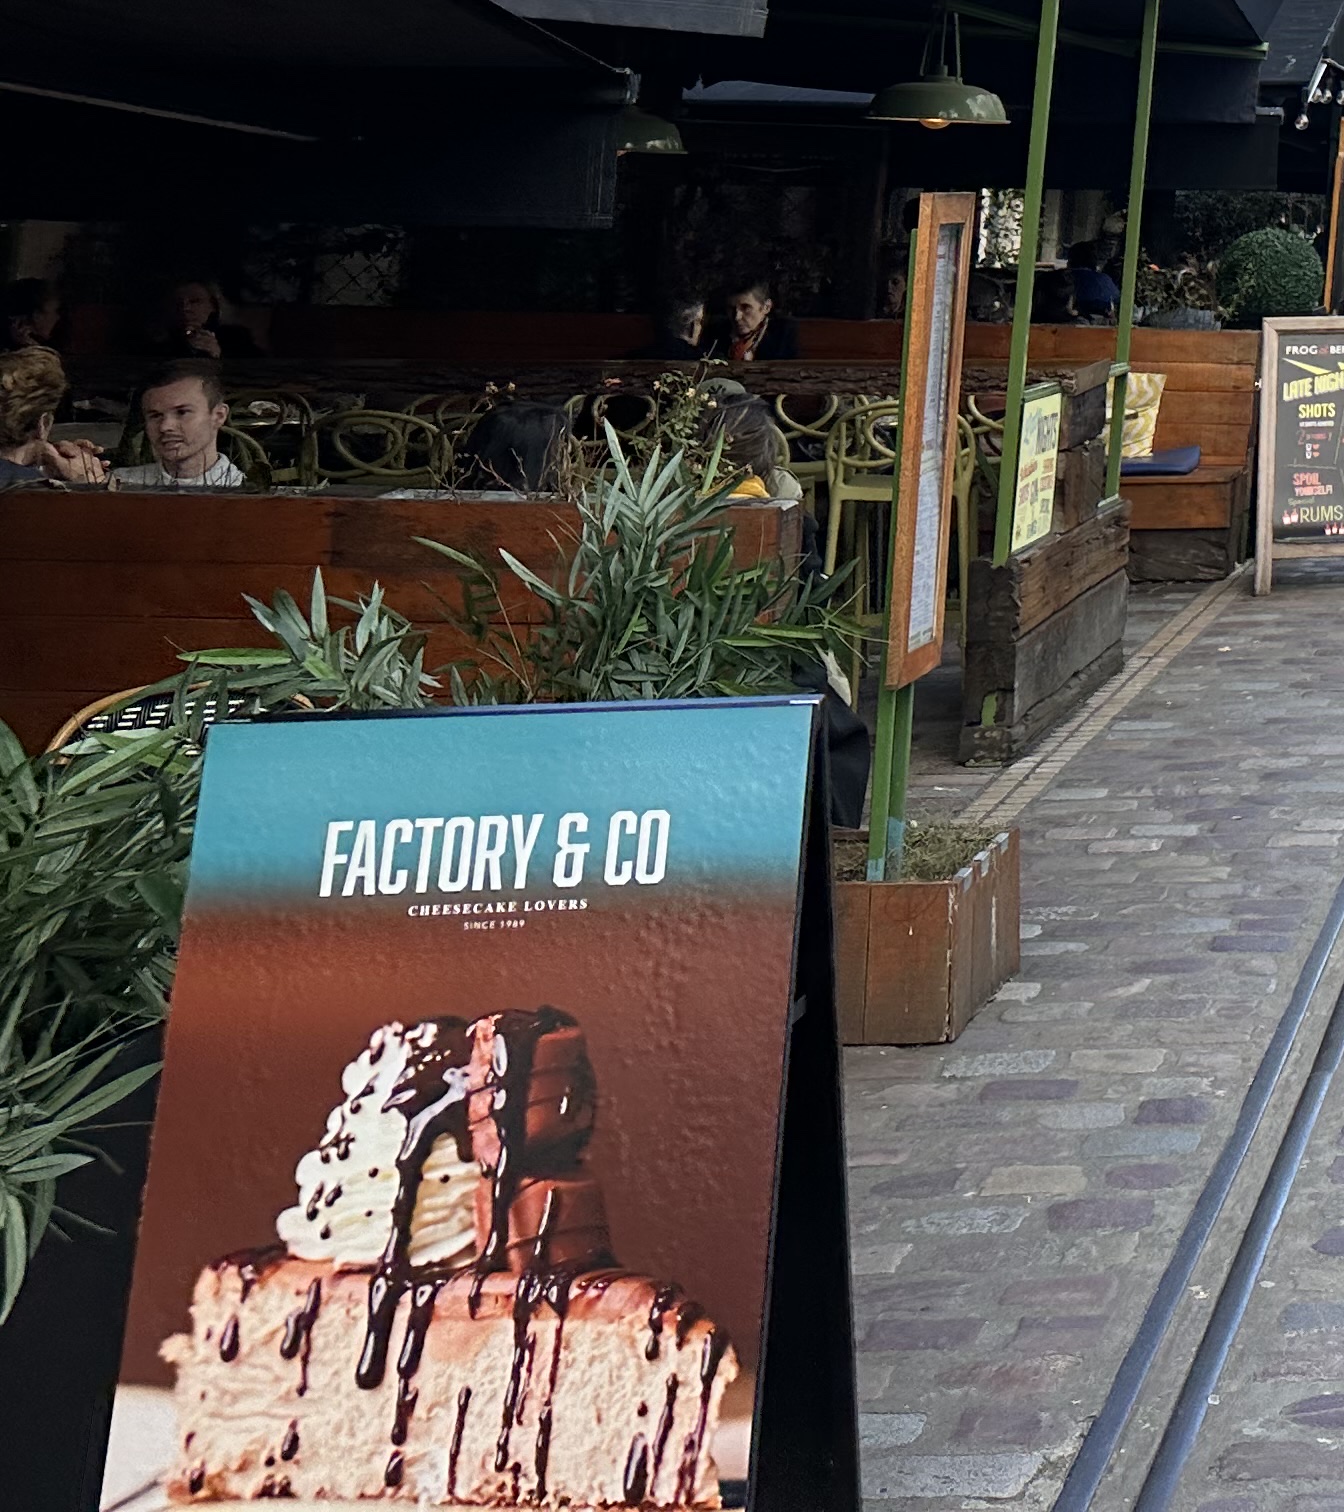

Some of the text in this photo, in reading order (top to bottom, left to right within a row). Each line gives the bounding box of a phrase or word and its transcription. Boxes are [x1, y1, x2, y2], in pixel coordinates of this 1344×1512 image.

[1285, 345, 1318, 355] FROG
[1283, 377, 1313, 402] LATE
[1298, 402, 1336, 419] SHOTS
[1292, 472, 1321, 486] SPOIL
[1299, 505, 1344, 524] RUMS
[319, 809, 671, 898] FACTORY & CO
[407, 899, 588, 918] CHEESECAKE LOVERS
[463, 920, 496, 930] SINCE
